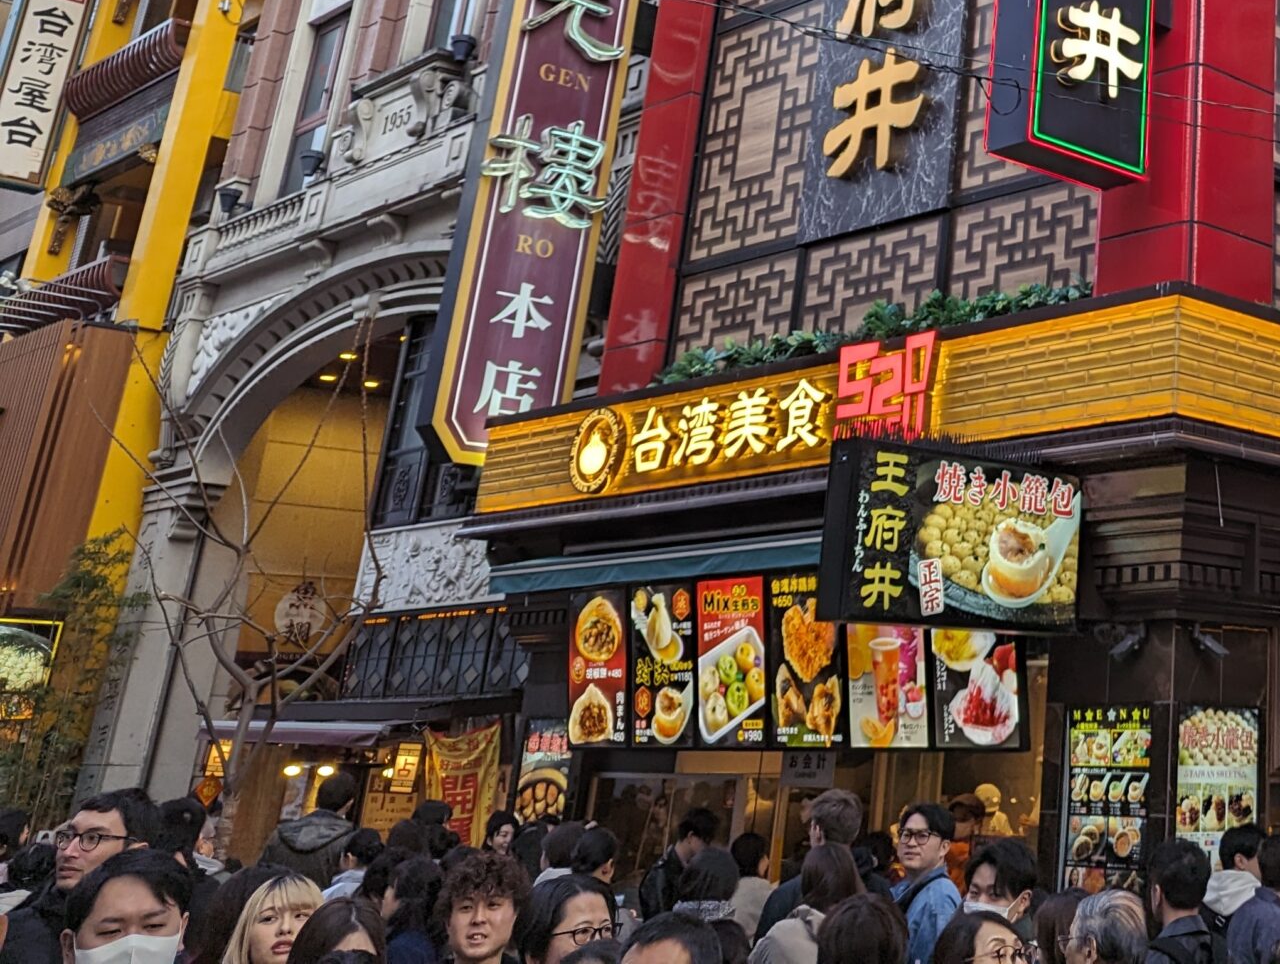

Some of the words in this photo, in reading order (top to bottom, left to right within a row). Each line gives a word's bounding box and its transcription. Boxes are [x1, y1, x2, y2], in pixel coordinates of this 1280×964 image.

[1, 6, 75, 148] 台湾屋台
[539, 62, 593, 94] GEN
[517, 233, 554, 259] RO
[473, 281, 554, 417] 本店
[631, 378, 829, 474] 台湾美食
[934, 460, 1076, 519] 焼き小籠包
[851, 489, 870, 573] わんふーちん
[860, 451, 910, 611] 王府井
[919, 560, 943, 615] 正宗
[789, 753, 827, 770] お会計
